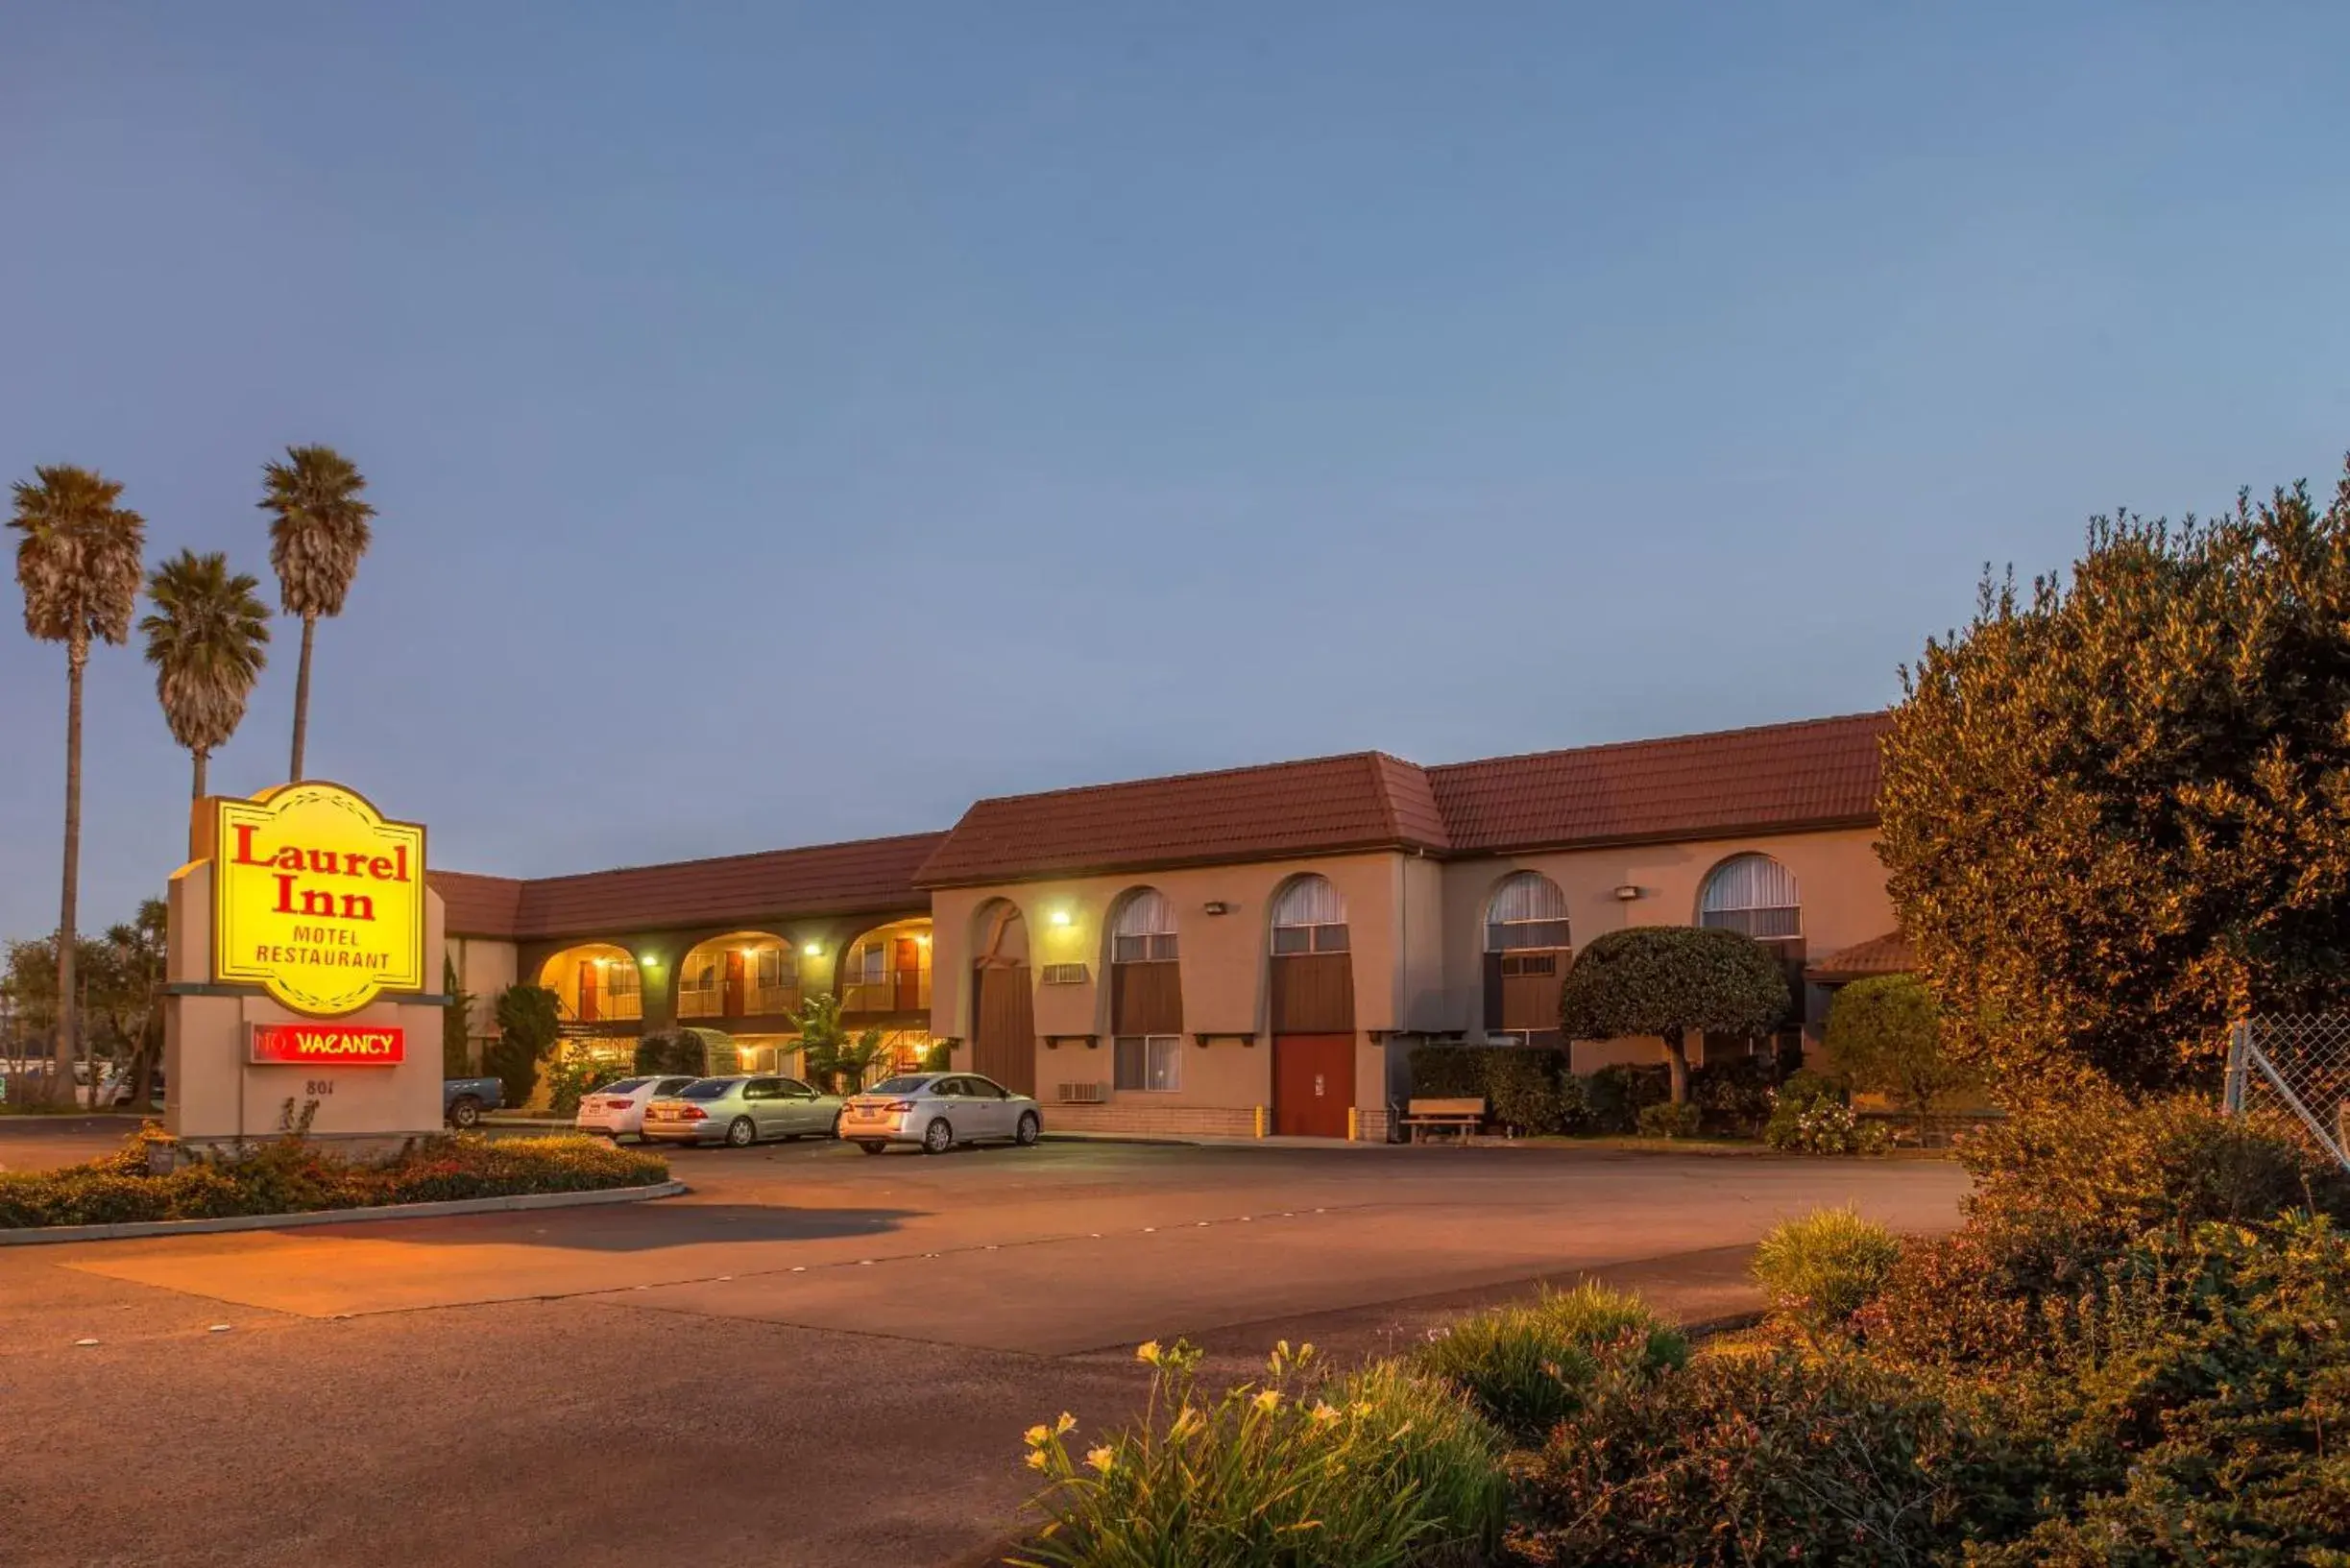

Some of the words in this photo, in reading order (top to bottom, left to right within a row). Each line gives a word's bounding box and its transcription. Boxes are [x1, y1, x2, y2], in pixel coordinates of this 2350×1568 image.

[231, 823, 411, 882] Laurel
[272, 874, 376, 921] Inn
[293, 925, 359, 946] MOTEL
[255, 945, 389, 969] RESTAURANT
[296, 1031, 394, 1054] VACANCY
[305, 1080, 333, 1095] 801
